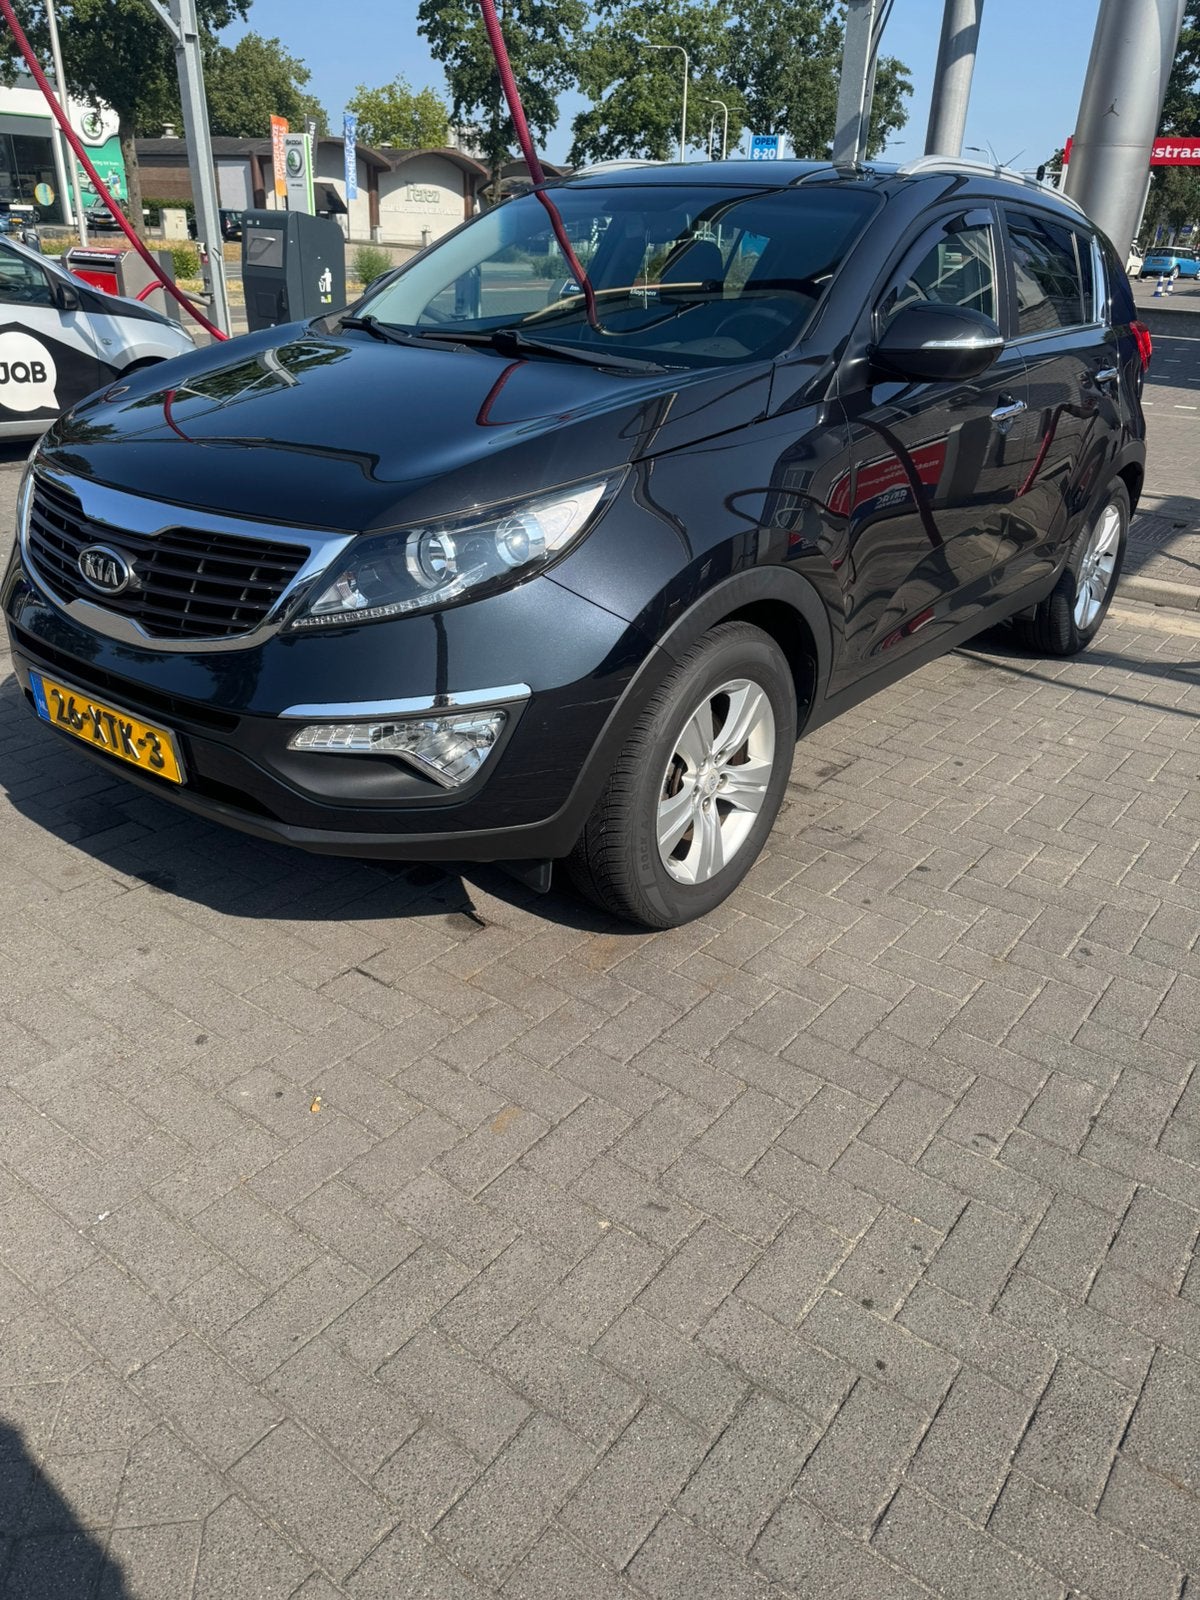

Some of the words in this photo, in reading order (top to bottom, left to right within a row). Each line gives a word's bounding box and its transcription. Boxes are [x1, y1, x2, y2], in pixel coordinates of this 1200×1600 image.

[754, 137, 777, 146] OPEN
[753, 147, 776, 160] 8-20
[84, 553, 118, 586] KIA
[51, 688, 165, 769] 26-XTK-3
